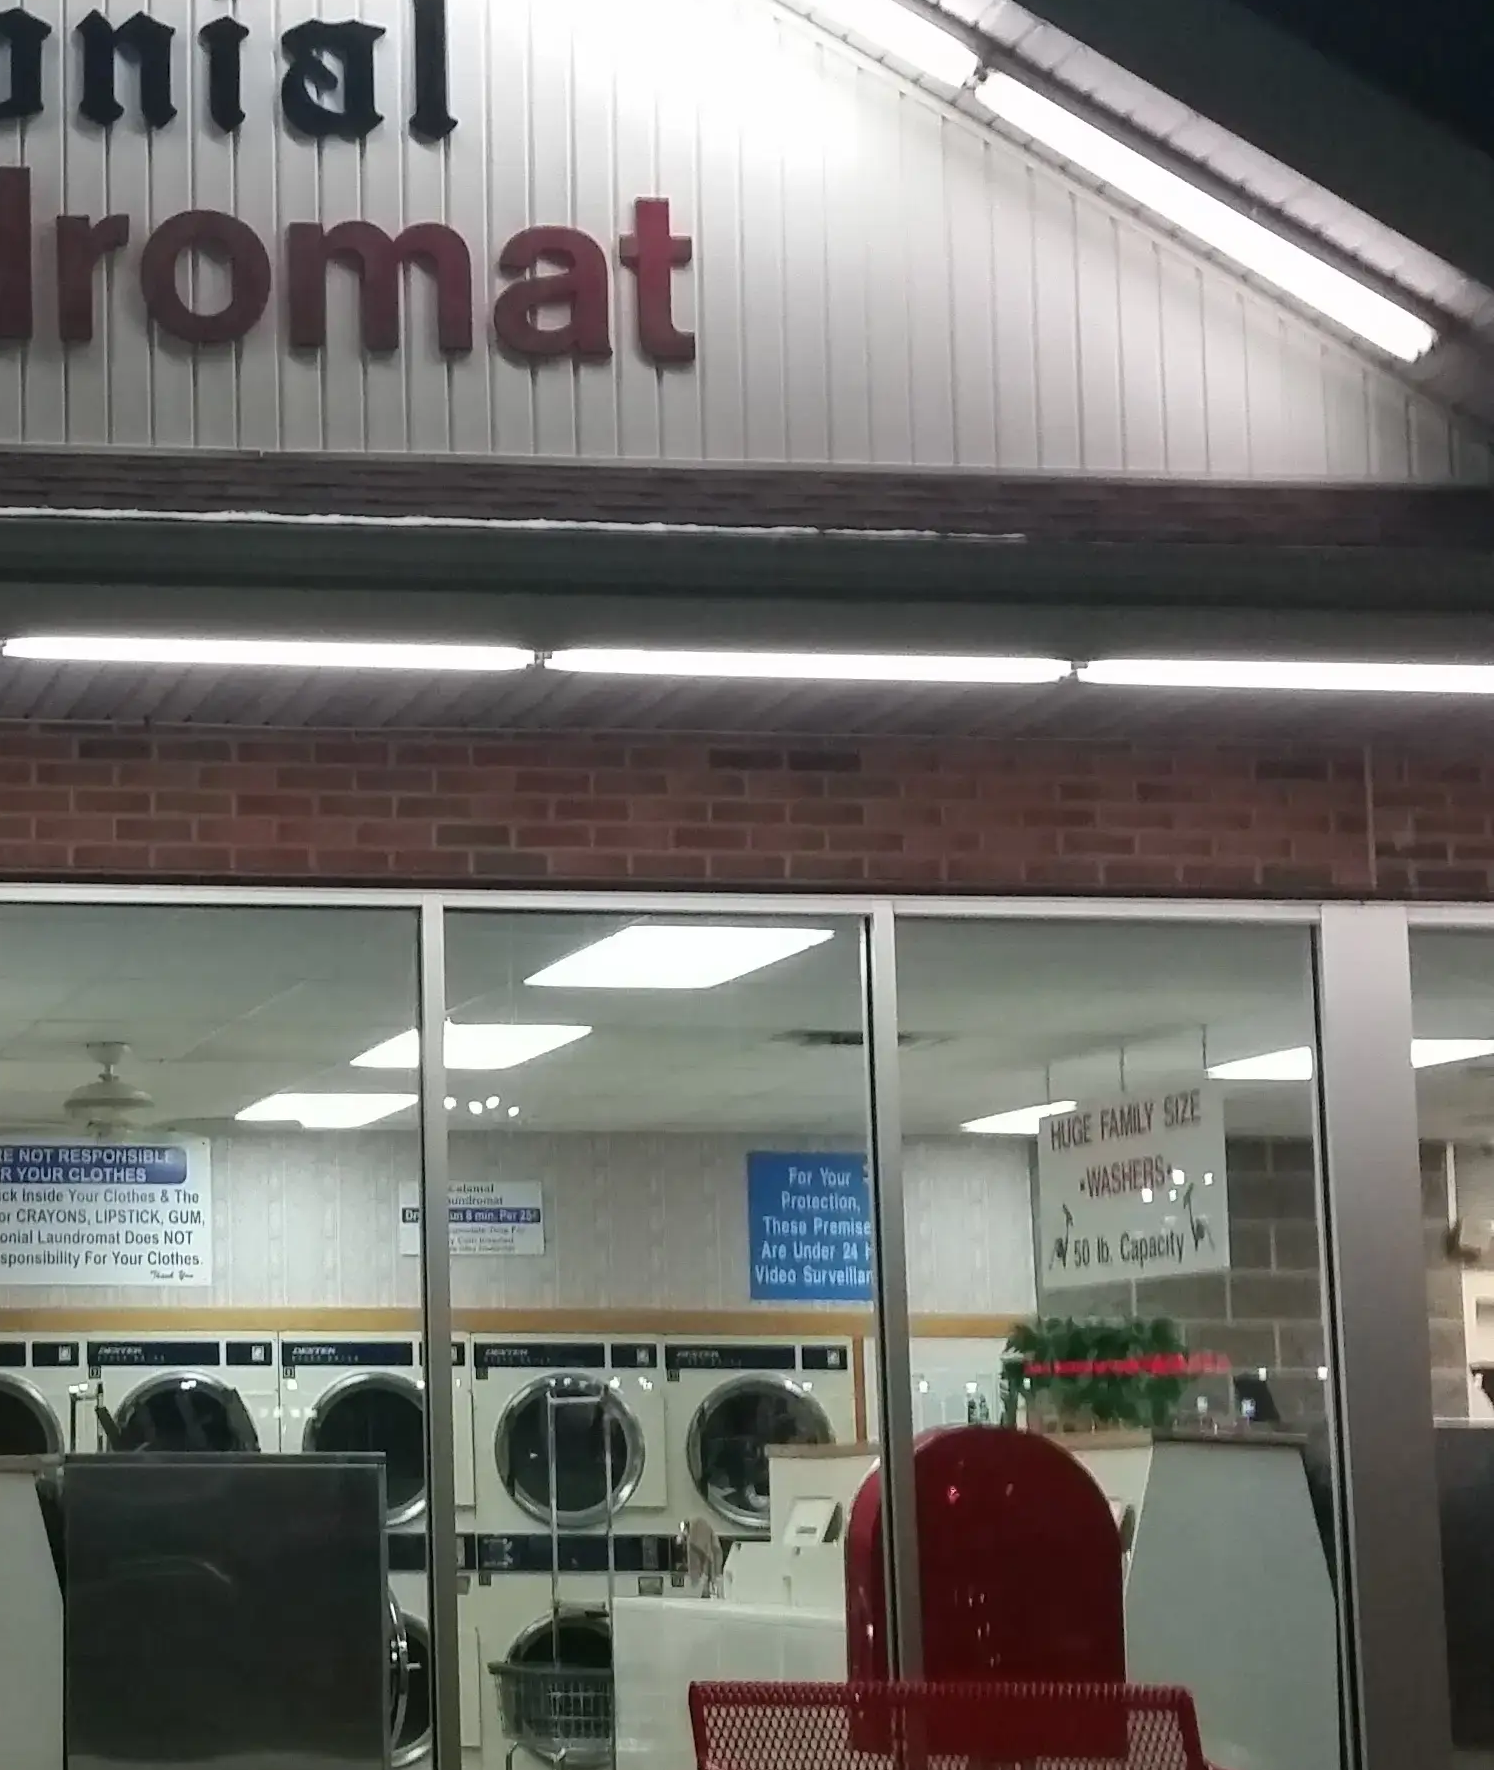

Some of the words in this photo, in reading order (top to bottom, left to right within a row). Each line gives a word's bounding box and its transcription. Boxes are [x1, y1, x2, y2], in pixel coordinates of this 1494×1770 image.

[1050, 1113, 1093, 1151] HUGE
[1099, 1102, 1154, 1141] FAMILY
[1163, 1088, 1201, 1127] SIZE
[18, 1148, 54, 1164] NOT
[58, 1148, 174, 1164] RESPONSIBLE
[17, 1166, 64, 1182] YOUR
[68, 1167, 147, 1183] CLOTHES
[788, 1166, 813, 1186] For
[819, 1166, 852, 1187] Your
[22, 1187, 64, 1203] Inside
[68, 1188, 99, 1203] Your
[103, 1188, 156, 1204] Clothes
[160, 1189, 170, 1204] &
[174, 1189, 200, 1205] The
[448, 1194, 503, 1206] undromat
[781, 1190, 861, 1213] Protection,
[16, 1208, 91, 1226] CRAYONS,
[95, 1209, 164, 1226] LIPSTICK,
[168, 1210, 205, 1227] GUM,
[762, 1215, 807, 1236] These
[813, 1216, 871, 1236] Premise
[37, 1228, 120, 1245] Laundromat
[125, 1230, 159, 1245] Does
[163, 1230, 194, 1245] NOT
[85, 1250, 107, 1265] For
[112, 1250, 144, 1266] Your
[147, 1250, 204, 1266] Clothes.
[761, 1240, 787, 1260] Are
[793, 1241, 836, 1261] Under
[842, 1241, 859, 1261] 24
[1074, 1237, 1090, 1267] 50
[1120, 1229, 1185, 1268] Capacity
[754, 1264, 797, 1286] Video
[802, 1264, 874, 1287] Surveillan
